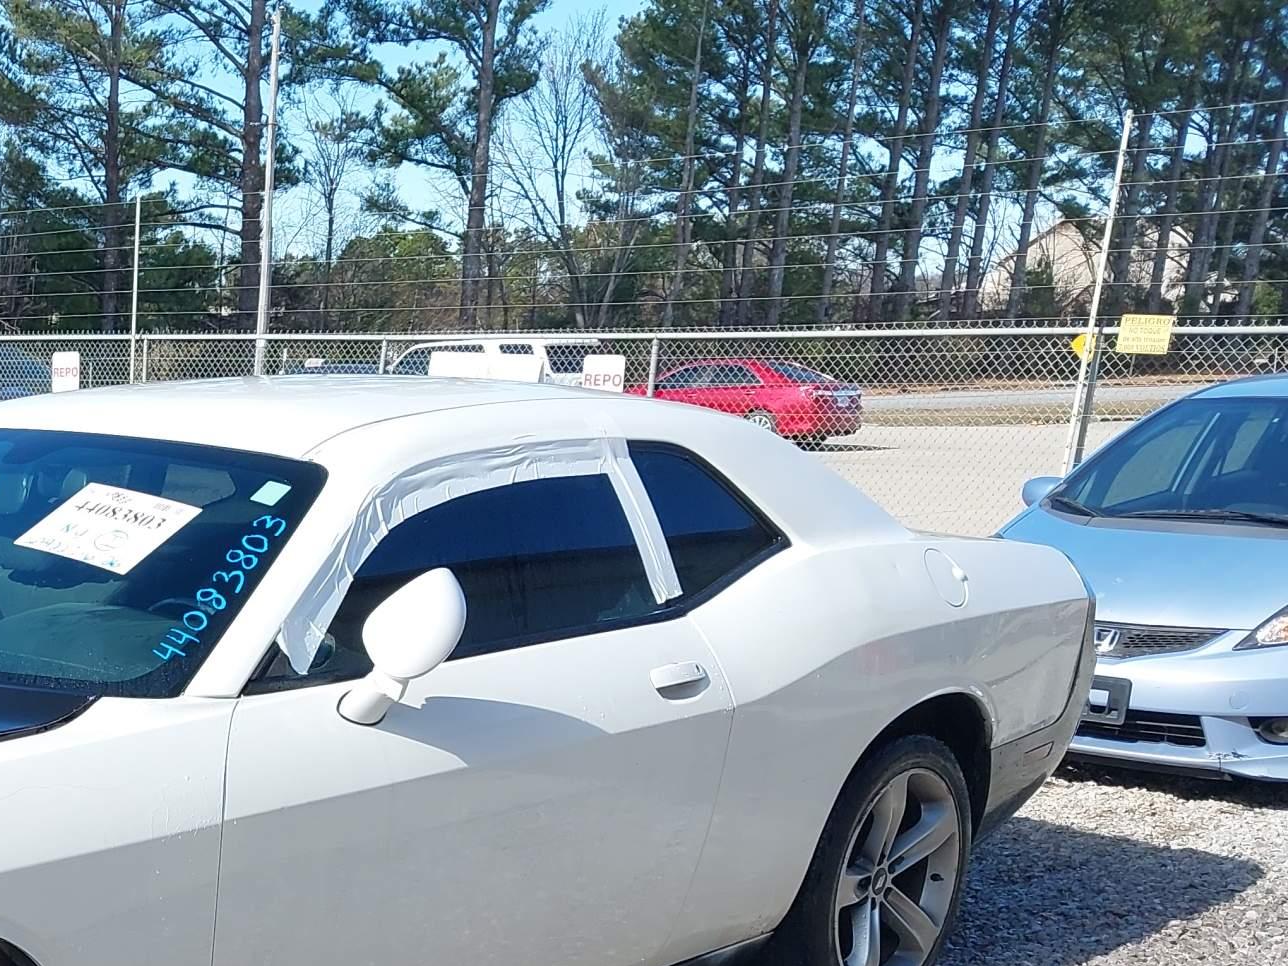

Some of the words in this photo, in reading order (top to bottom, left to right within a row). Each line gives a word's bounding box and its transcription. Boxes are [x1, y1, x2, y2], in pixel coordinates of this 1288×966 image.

[1124, 317, 1171, 326] PELIGRO
[54, 367, 78, 377] REPO
[584, 374, 622, 387] REPO
[74, 499, 168, 531] 44083803
[153, 515, 287, 663] 44083803
